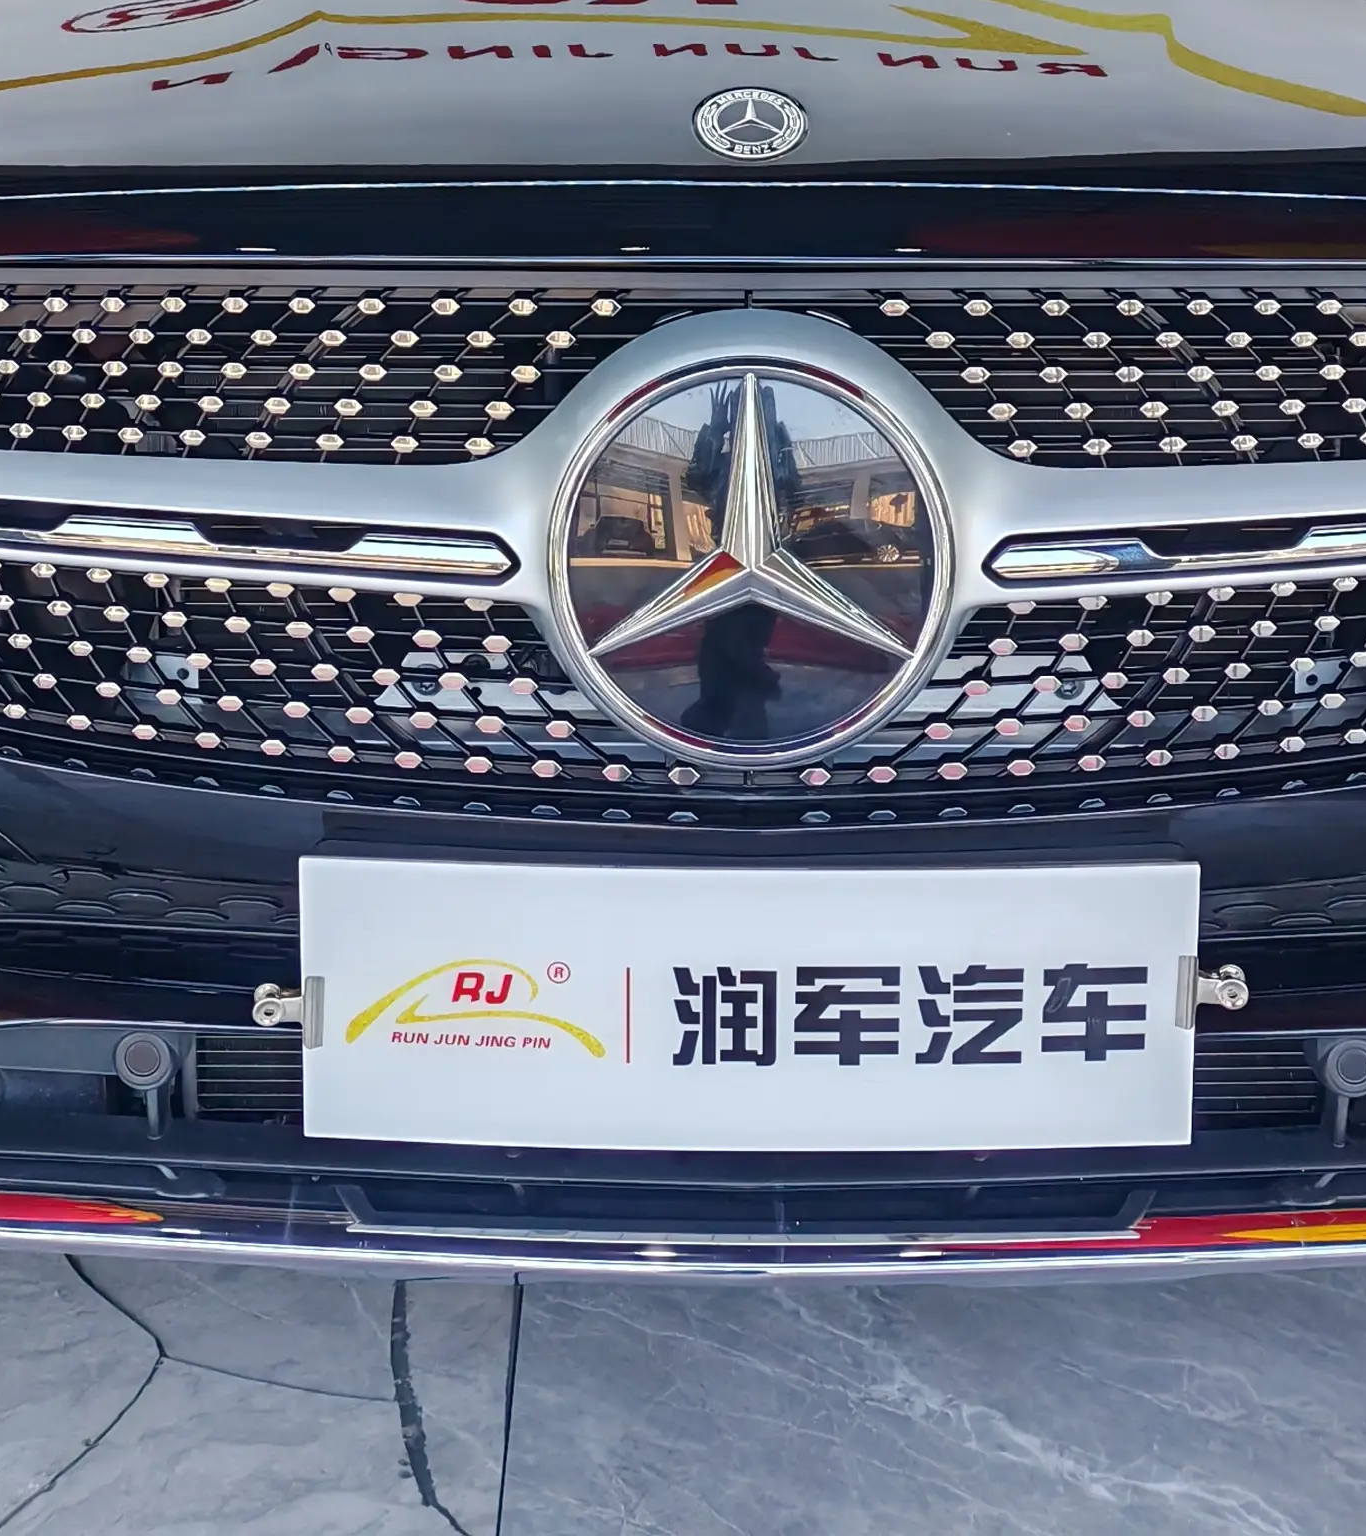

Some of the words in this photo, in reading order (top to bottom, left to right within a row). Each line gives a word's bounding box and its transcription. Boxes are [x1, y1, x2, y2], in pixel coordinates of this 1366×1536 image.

[715, 90, 786, 107] MERCEDES
[733, 144, 772, 155] BENZ
[451, 972, 514, 1005] RJ
[672, 964, 1150, 1068] 润军汽车
[390, 1031, 430, 1045] RUN
[434, 1033, 471, 1047] JUN
[475, 1035, 517, 1049] JING
[521, 1036, 552, 1050] PIN
